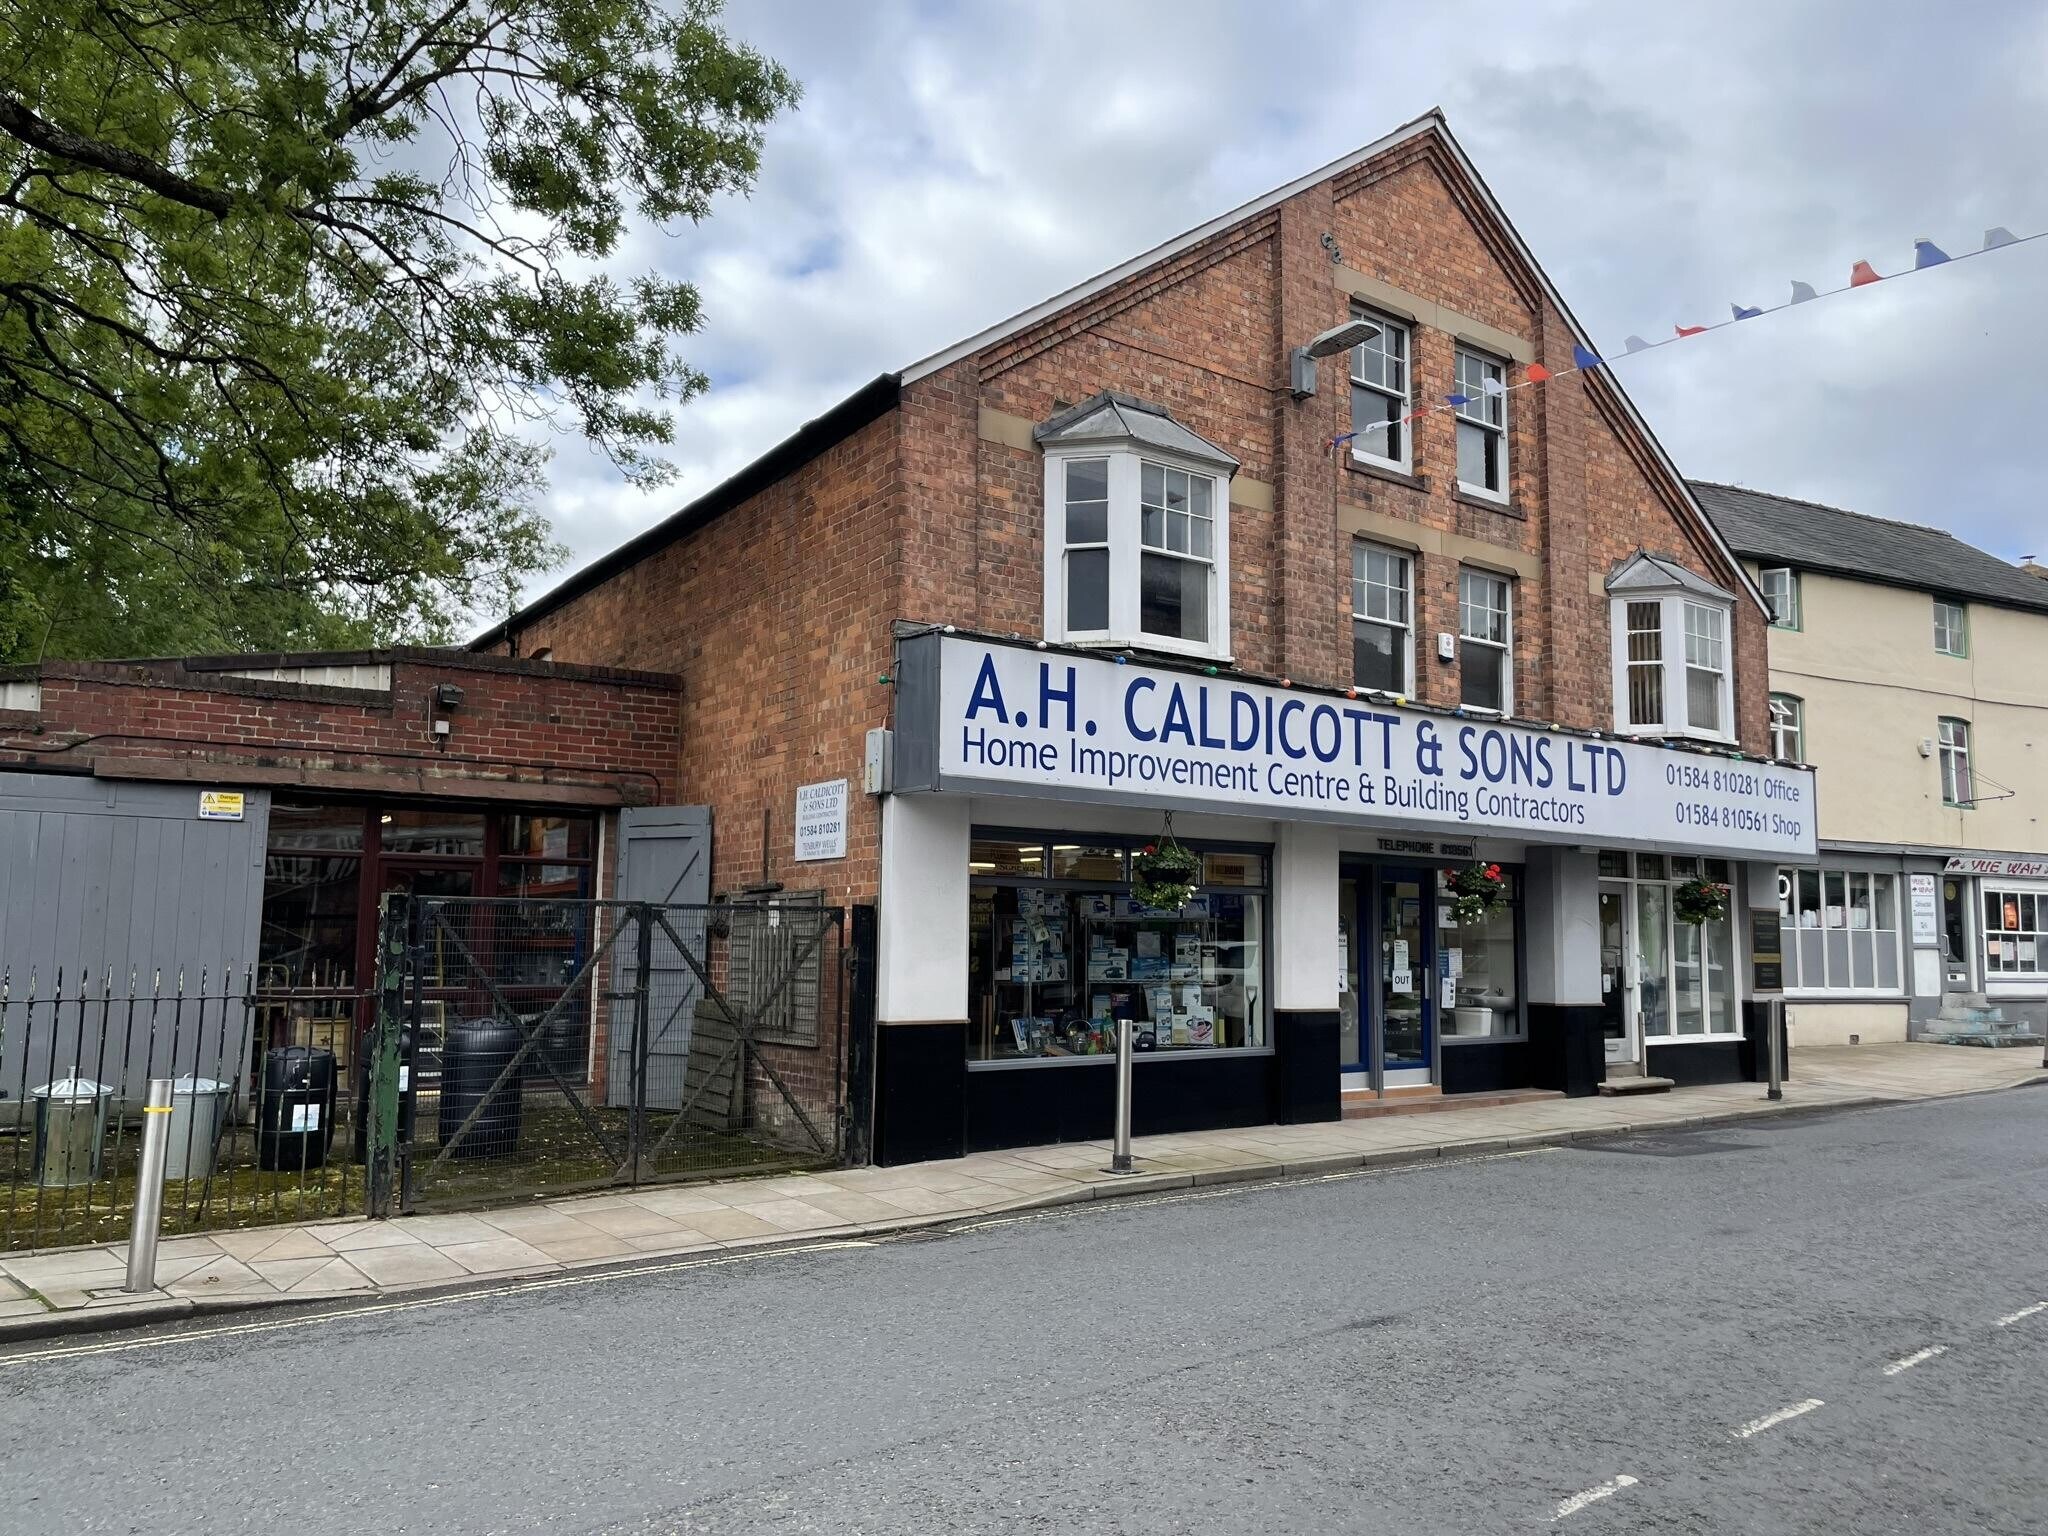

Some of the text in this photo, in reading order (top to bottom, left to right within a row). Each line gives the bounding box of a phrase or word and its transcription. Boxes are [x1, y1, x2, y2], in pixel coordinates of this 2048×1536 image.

[1124, 676, 1401, 770] CALDICOTT
[1415, 719, 1444, 777] &
[1458, 725, 1554, 789] SONS
[1566, 741, 1626, 796] LTD
[963, 725, 1585, 825] Home Improvement Centre & Building Contractors
[1666, 763, 1800, 803] 01584 810281 Office
[800, 822, 841, 837] 01584 810281
[1675, 801, 1801, 838] 01584 810561 Shop
[1377, 838, 1434, 854] TELEPHONE
[1971, 860, 2042, 875] YUE WAH
[1394, 975, 1411, 985] OUT
